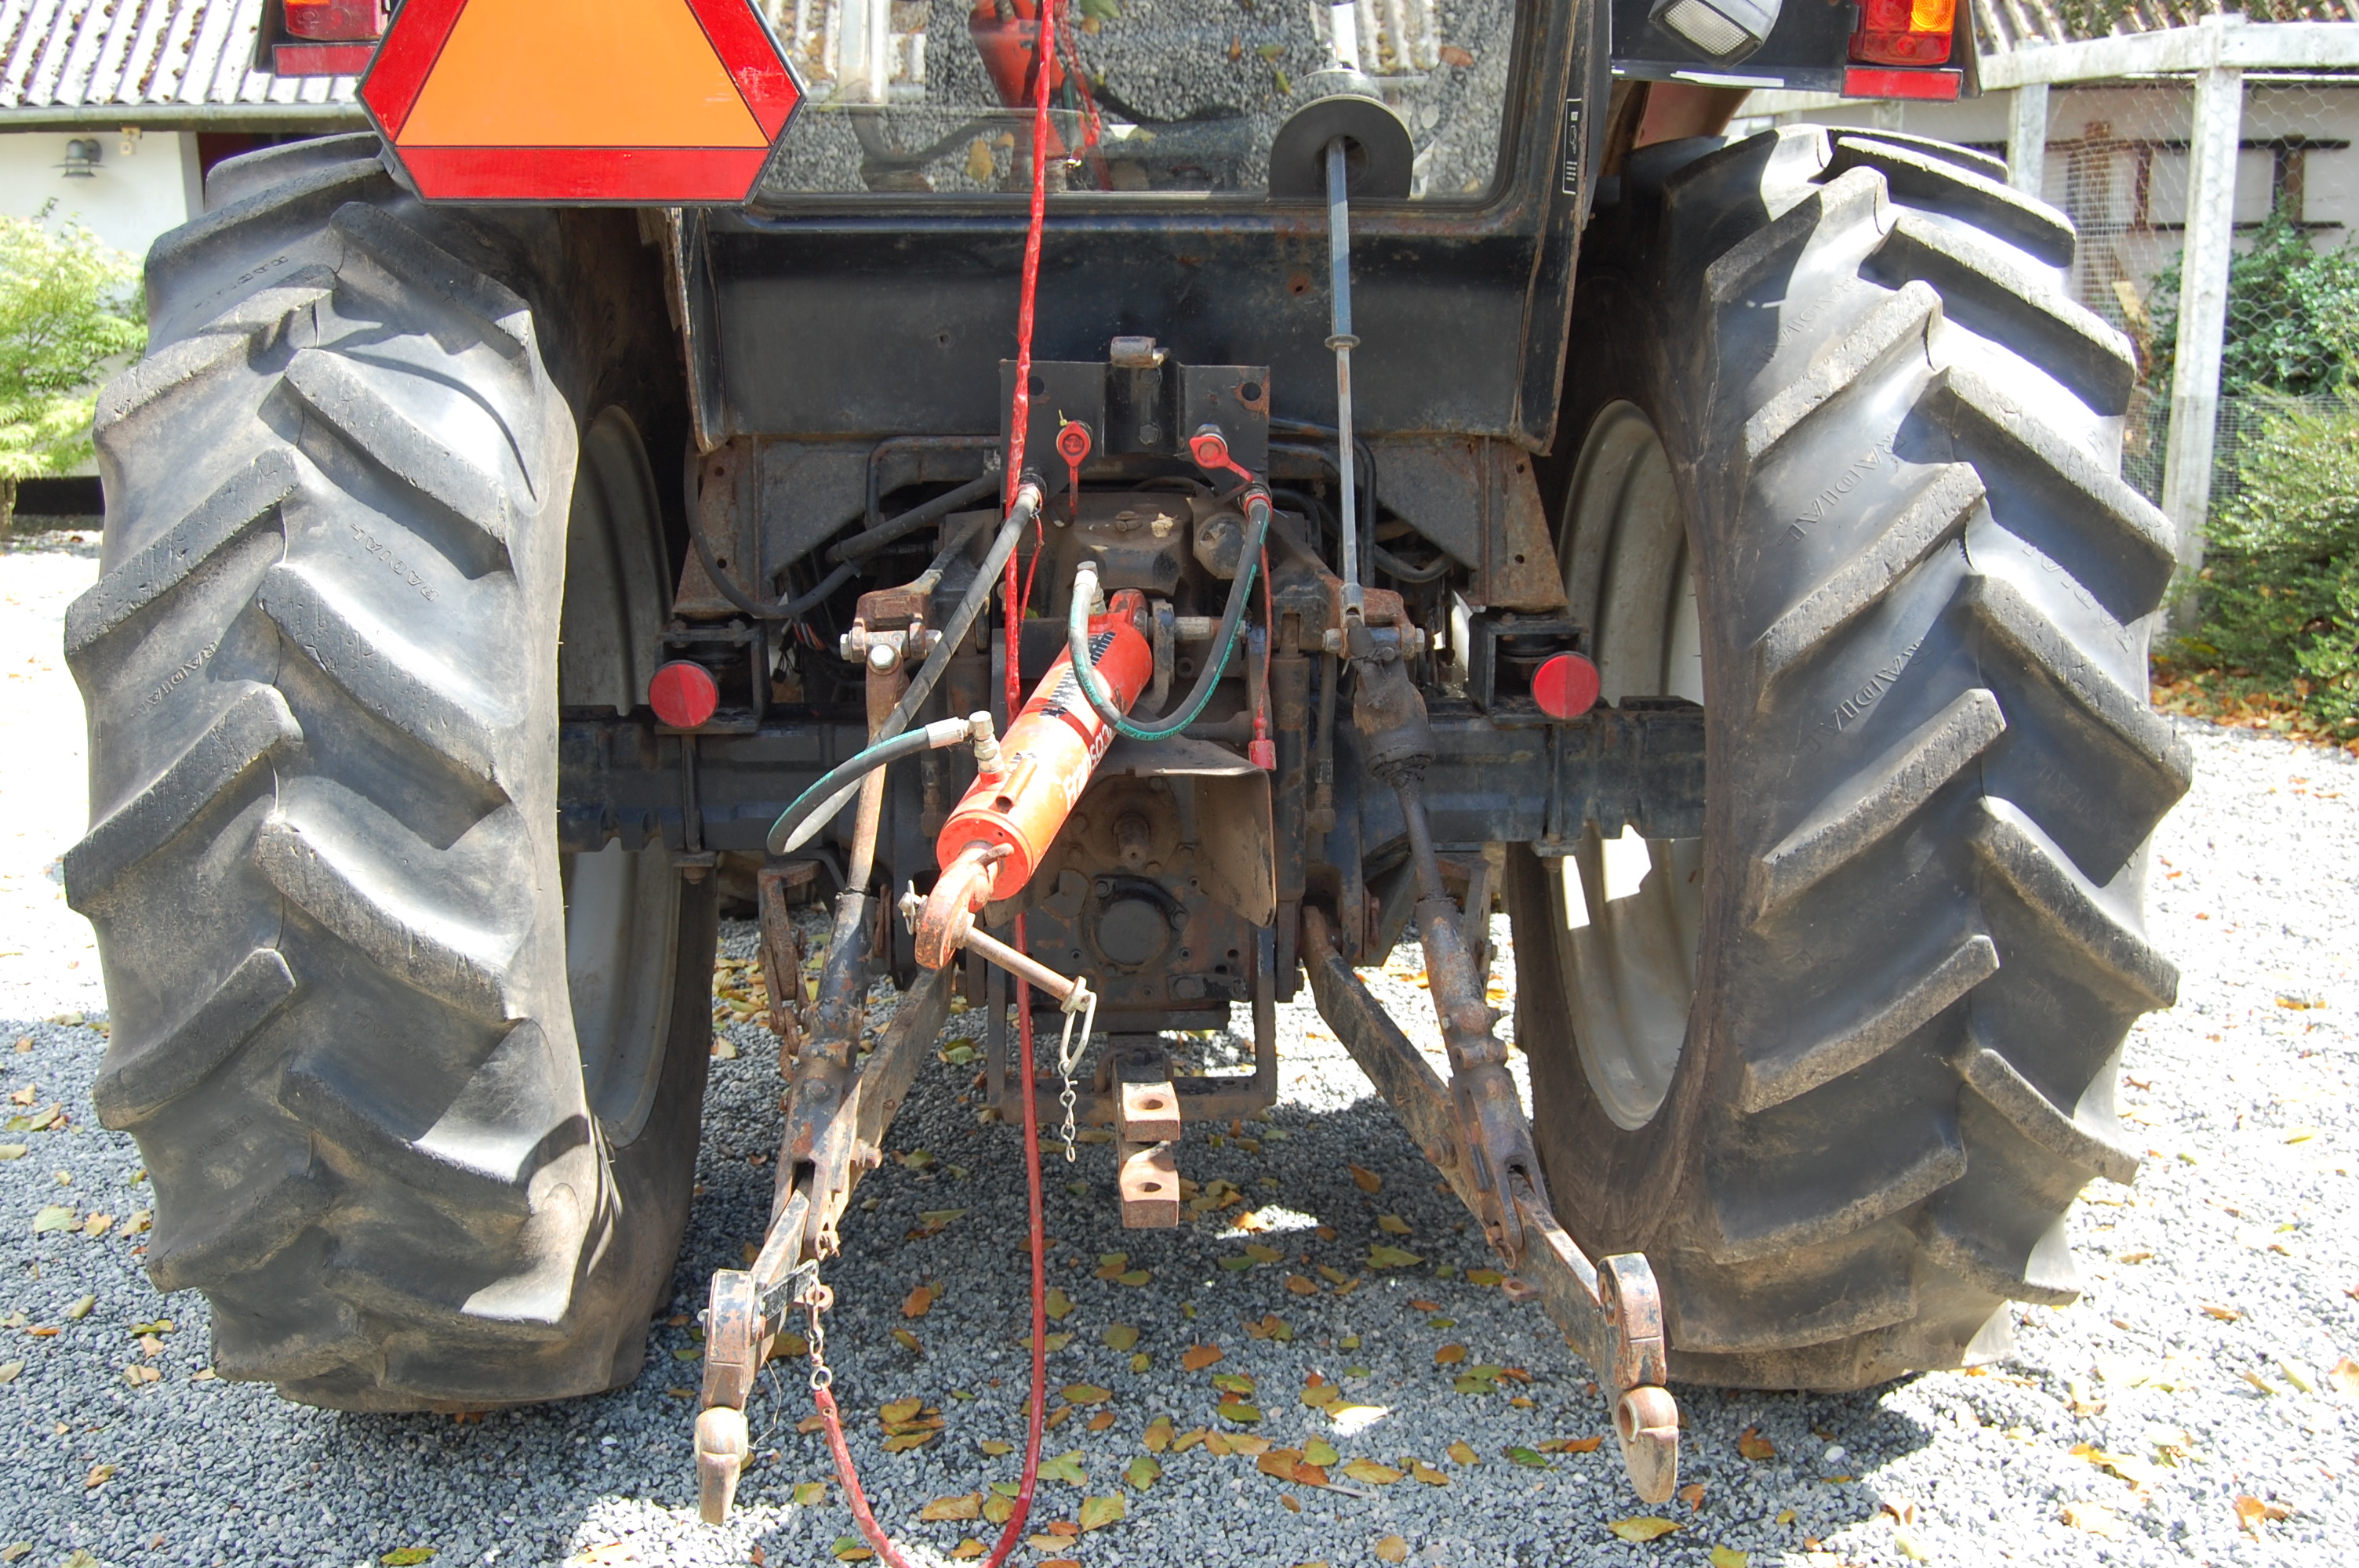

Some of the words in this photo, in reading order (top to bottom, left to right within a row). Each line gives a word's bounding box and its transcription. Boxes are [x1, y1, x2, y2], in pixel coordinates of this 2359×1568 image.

[1777, 432, 1908, 546] RADIAL
[351, 523, 441, 602] RADIAL
[1081, 677, 1096, 699] BAR
[1807, 637, 1935, 753] RADIAL
